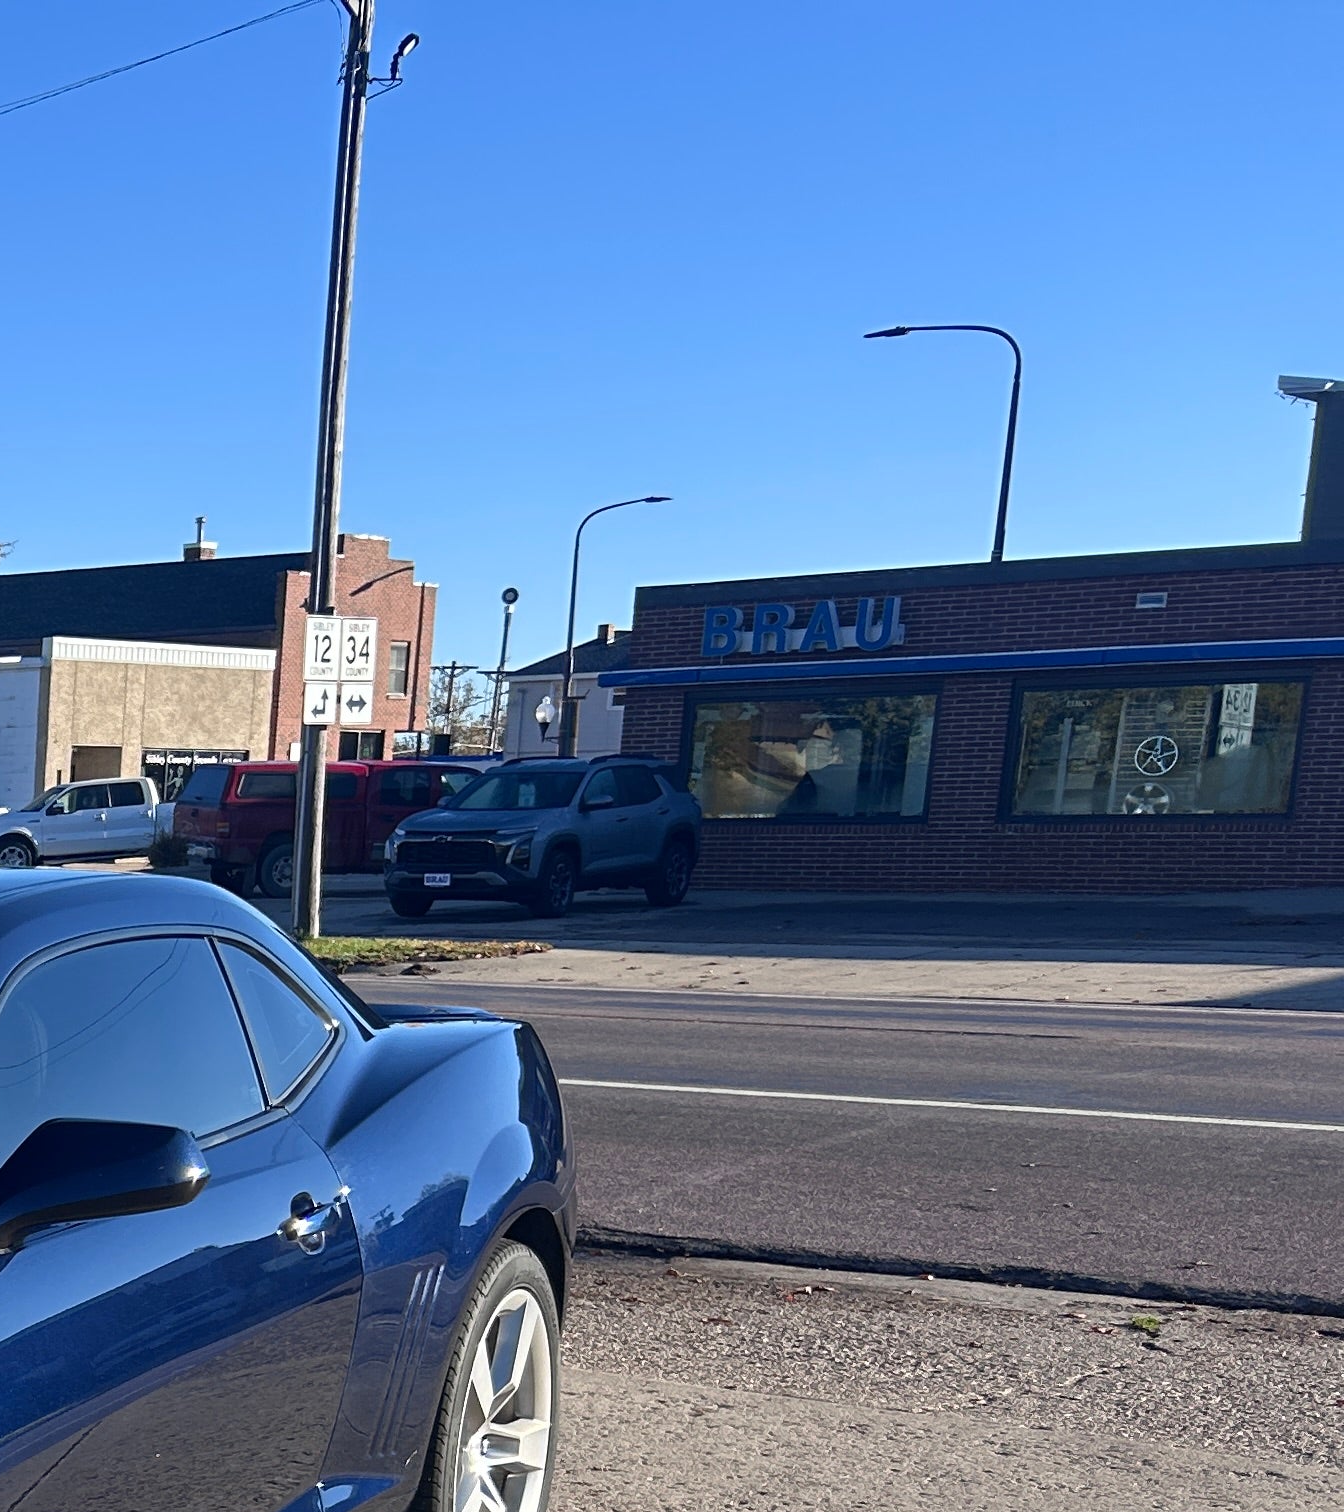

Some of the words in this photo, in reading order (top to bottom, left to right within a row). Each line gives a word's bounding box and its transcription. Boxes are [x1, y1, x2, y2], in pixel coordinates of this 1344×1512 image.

[313, 621, 335, 631] SIBLEY
[348, 623, 370, 633] SIBLEY
[701, 596, 900, 657] BRAU
[314, 634, 332, 663] 12
[345, 635, 370, 664] 34
[309, 666, 334, 676] COUNTY
[345, 667, 369, 677] COUNTY
